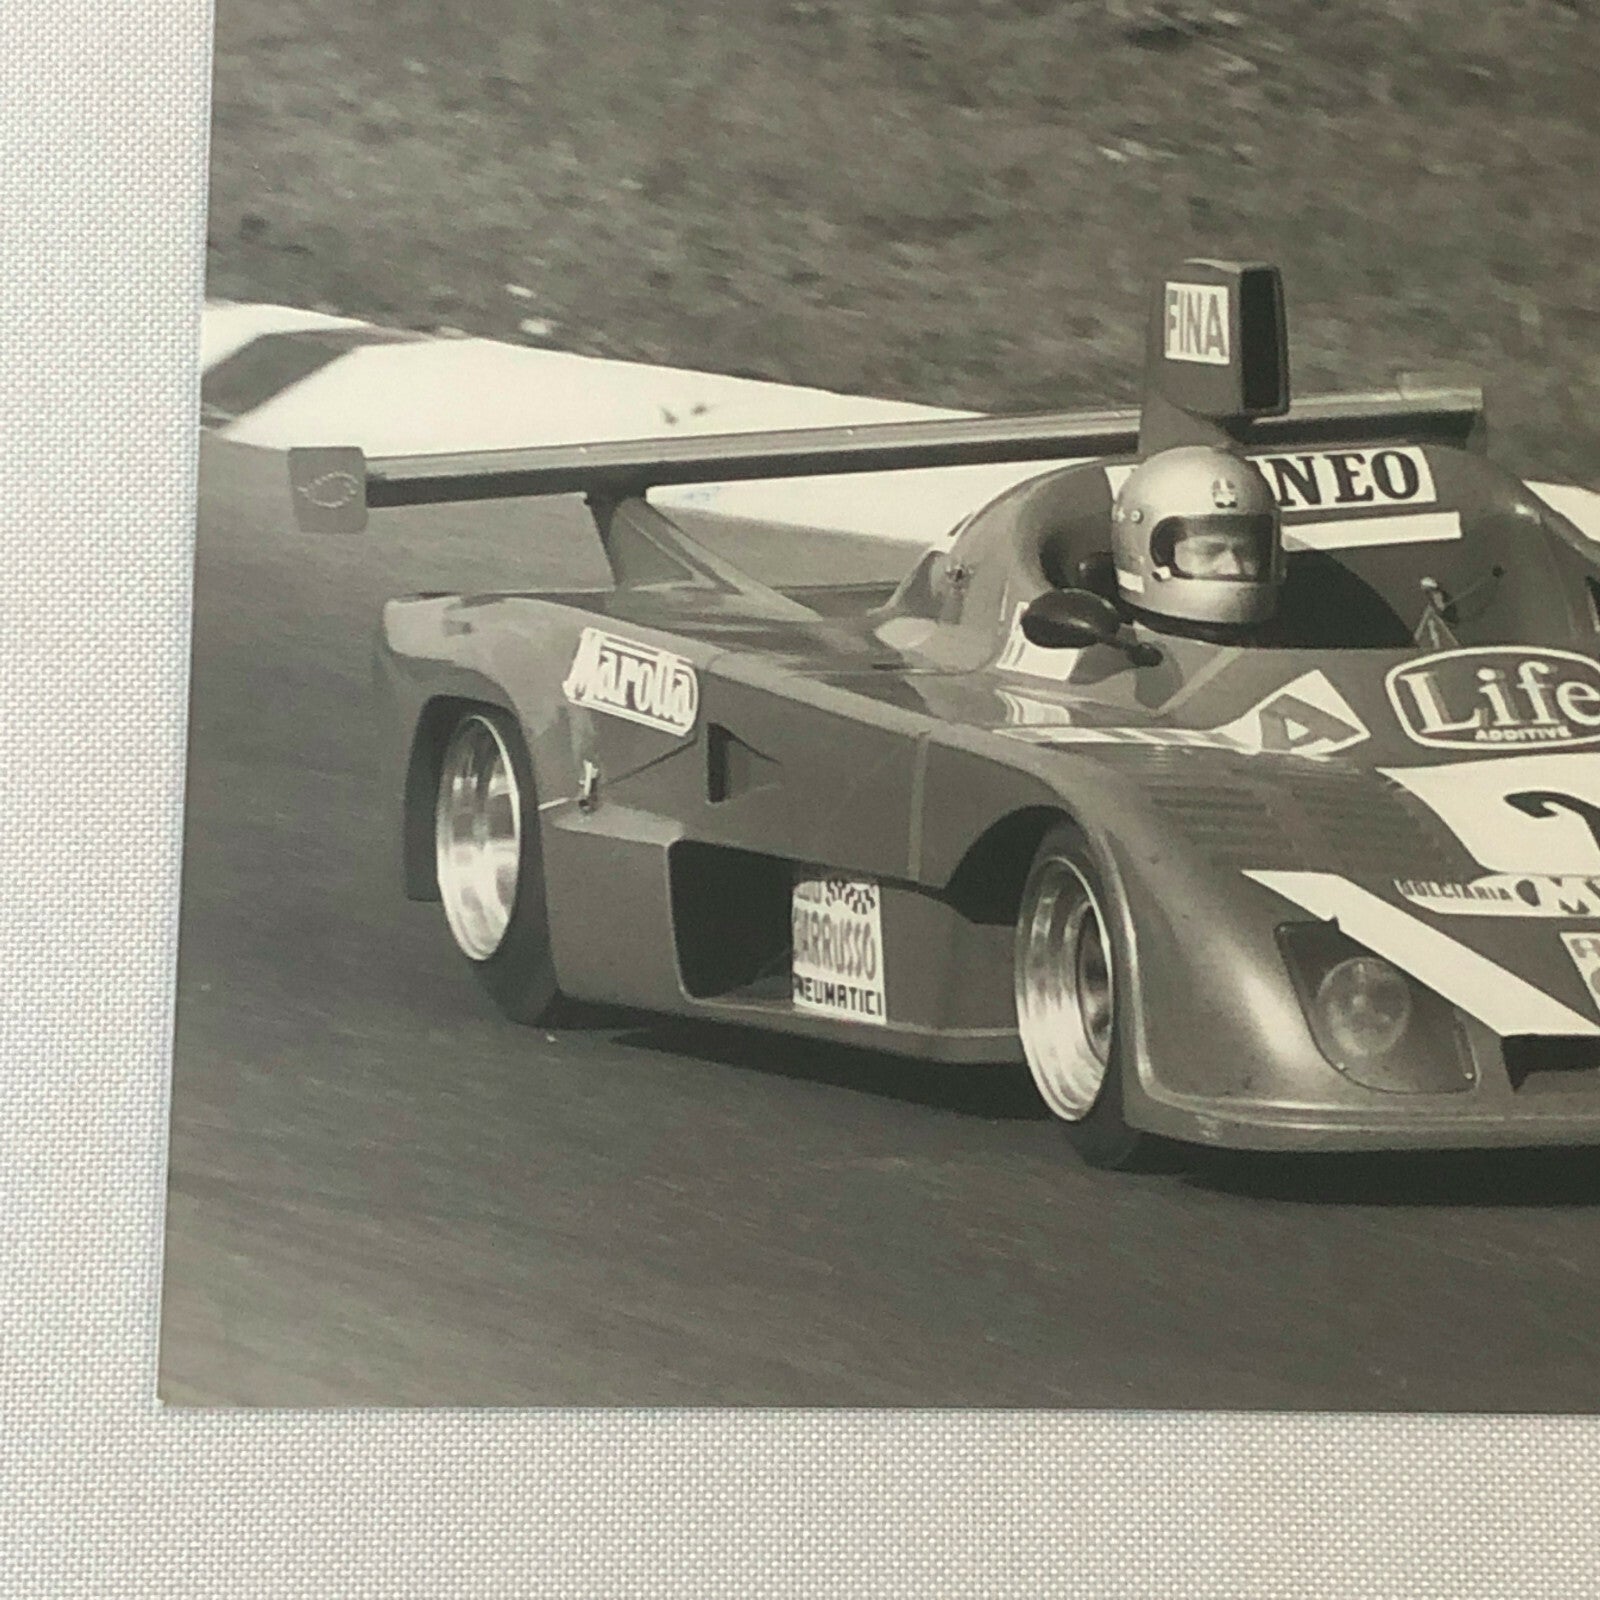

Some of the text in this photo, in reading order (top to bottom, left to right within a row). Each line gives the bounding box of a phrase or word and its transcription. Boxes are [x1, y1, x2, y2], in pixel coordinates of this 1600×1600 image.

[1166, 288, 1228, 358] FINA
[1264, 449, 1420, 506] NEO
[1400, 660, 1600, 734] Life
[1474, 726, 1572, 742] ADDITIVE
